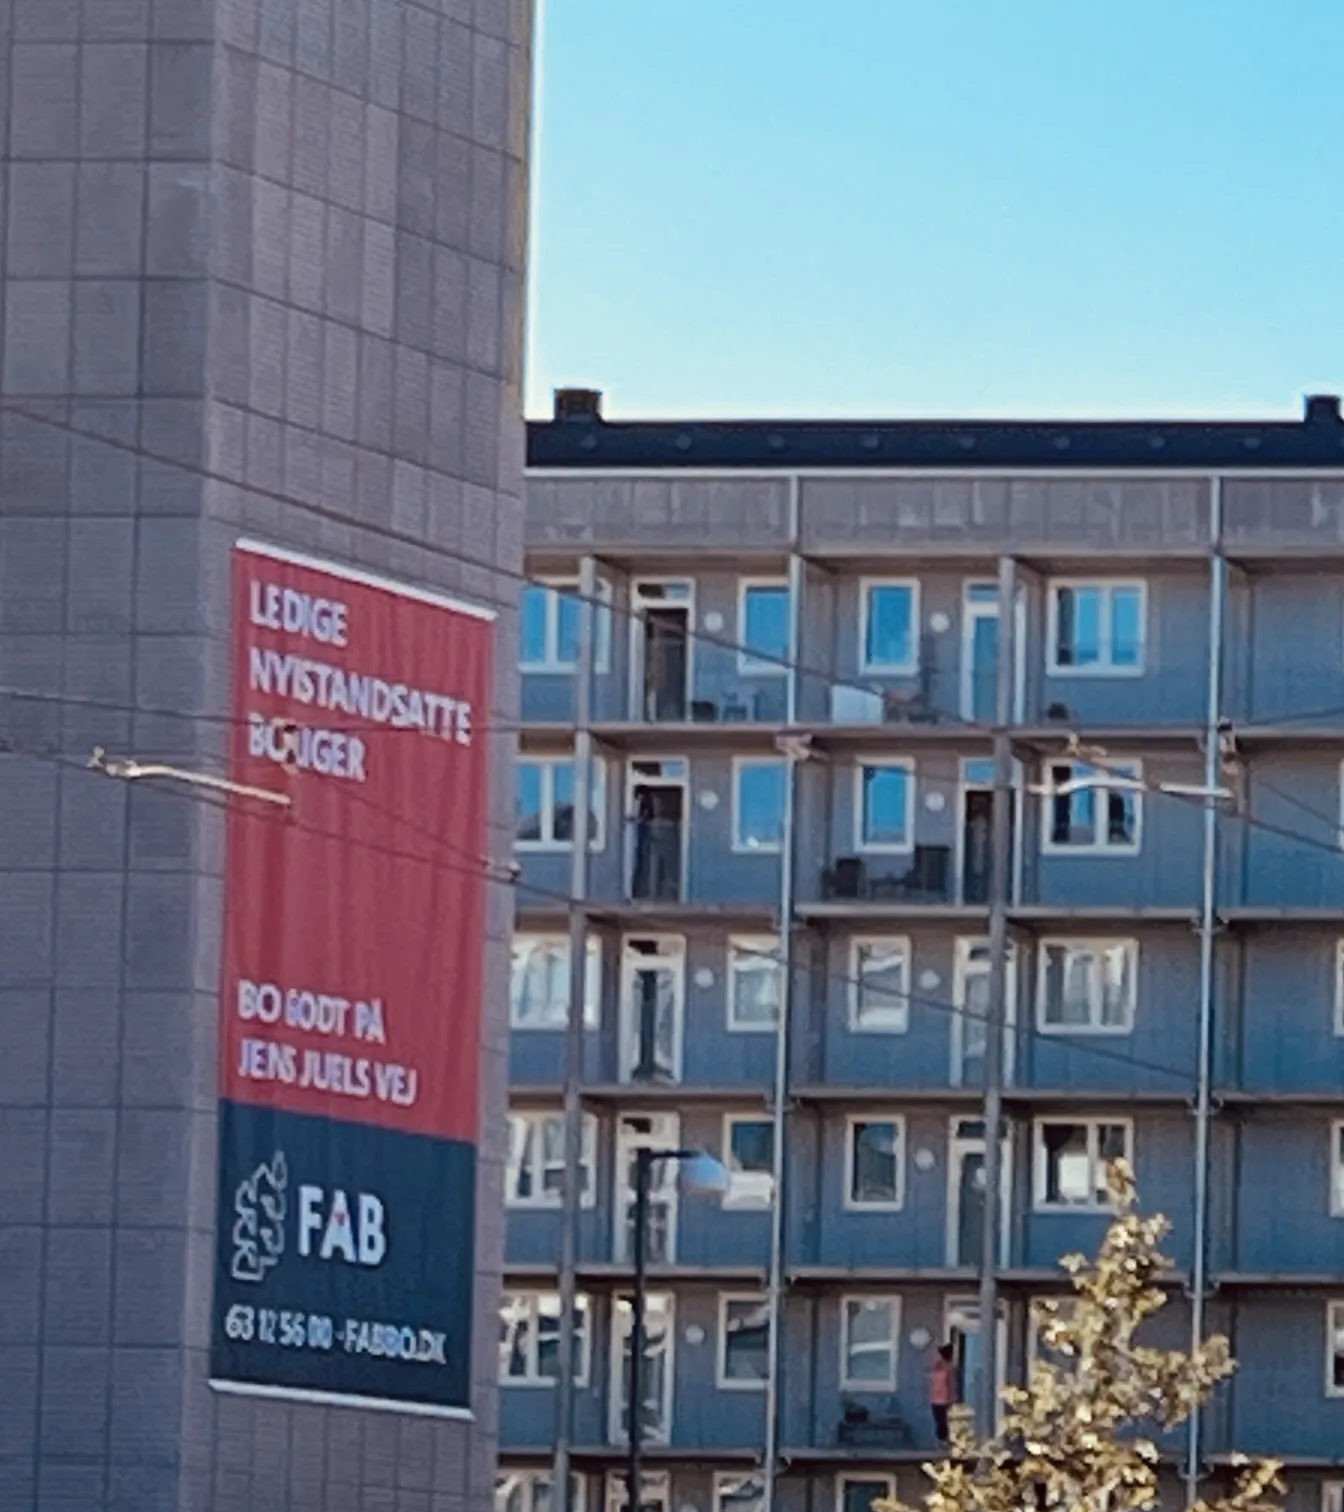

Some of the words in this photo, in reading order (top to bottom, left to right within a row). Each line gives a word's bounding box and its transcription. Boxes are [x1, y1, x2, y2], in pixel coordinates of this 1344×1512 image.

[251, 580, 347, 646] LEDIGE
[250, 646, 471, 746] NYISTANDSATTE
[248, 712, 365, 782] BOIGER
[238, 979, 282, 1023] BO
[285, 988, 350, 1037] GODT
[353, 996, 385, 1045] PÅ
[238, 1037, 297, 1084] JENS
[300, 1049, 370, 1097] JUELS
[373, 1061, 417, 1106] VEJ
[298, 1184, 386, 1265] FAB
[225, 1303, 254, 1341] 63
